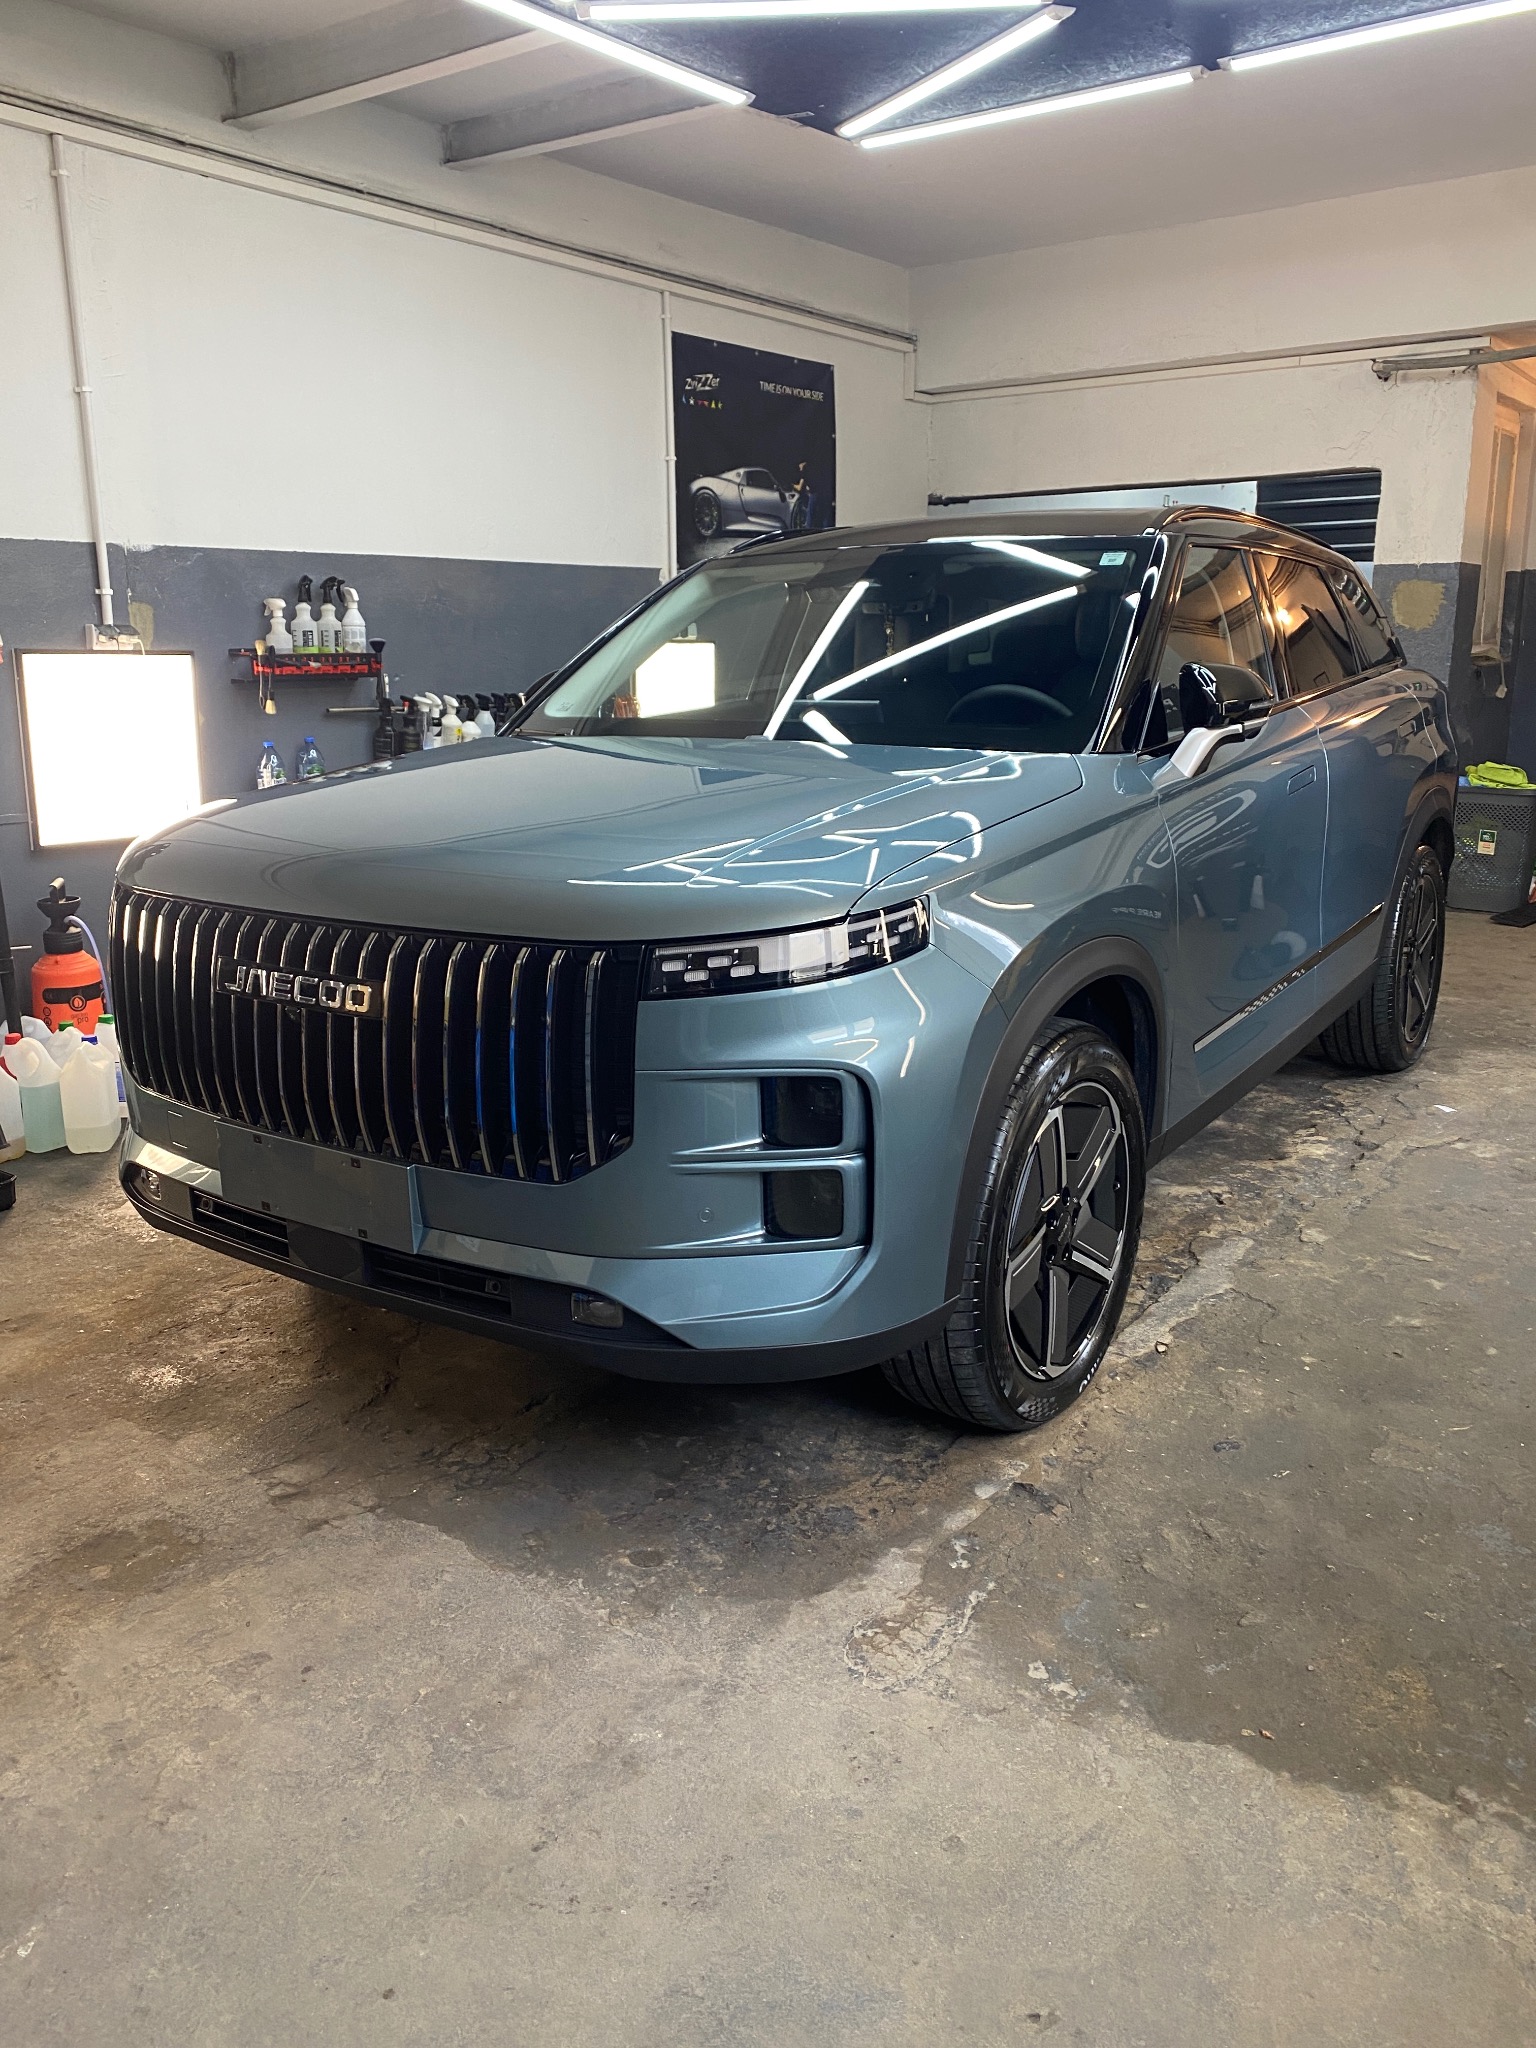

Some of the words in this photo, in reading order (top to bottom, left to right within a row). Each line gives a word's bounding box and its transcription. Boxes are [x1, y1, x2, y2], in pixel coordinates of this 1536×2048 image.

[760, 380, 775, 394] TIME
[776, 384, 782, 394] IS
[782, 385, 792, 395] ON
[792, 387, 811, 399] YOUR
[811, 390, 824, 402] SIDE
[224, 965, 372, 1012] JAECOO
[77, 1016, 89, 1025] pro
